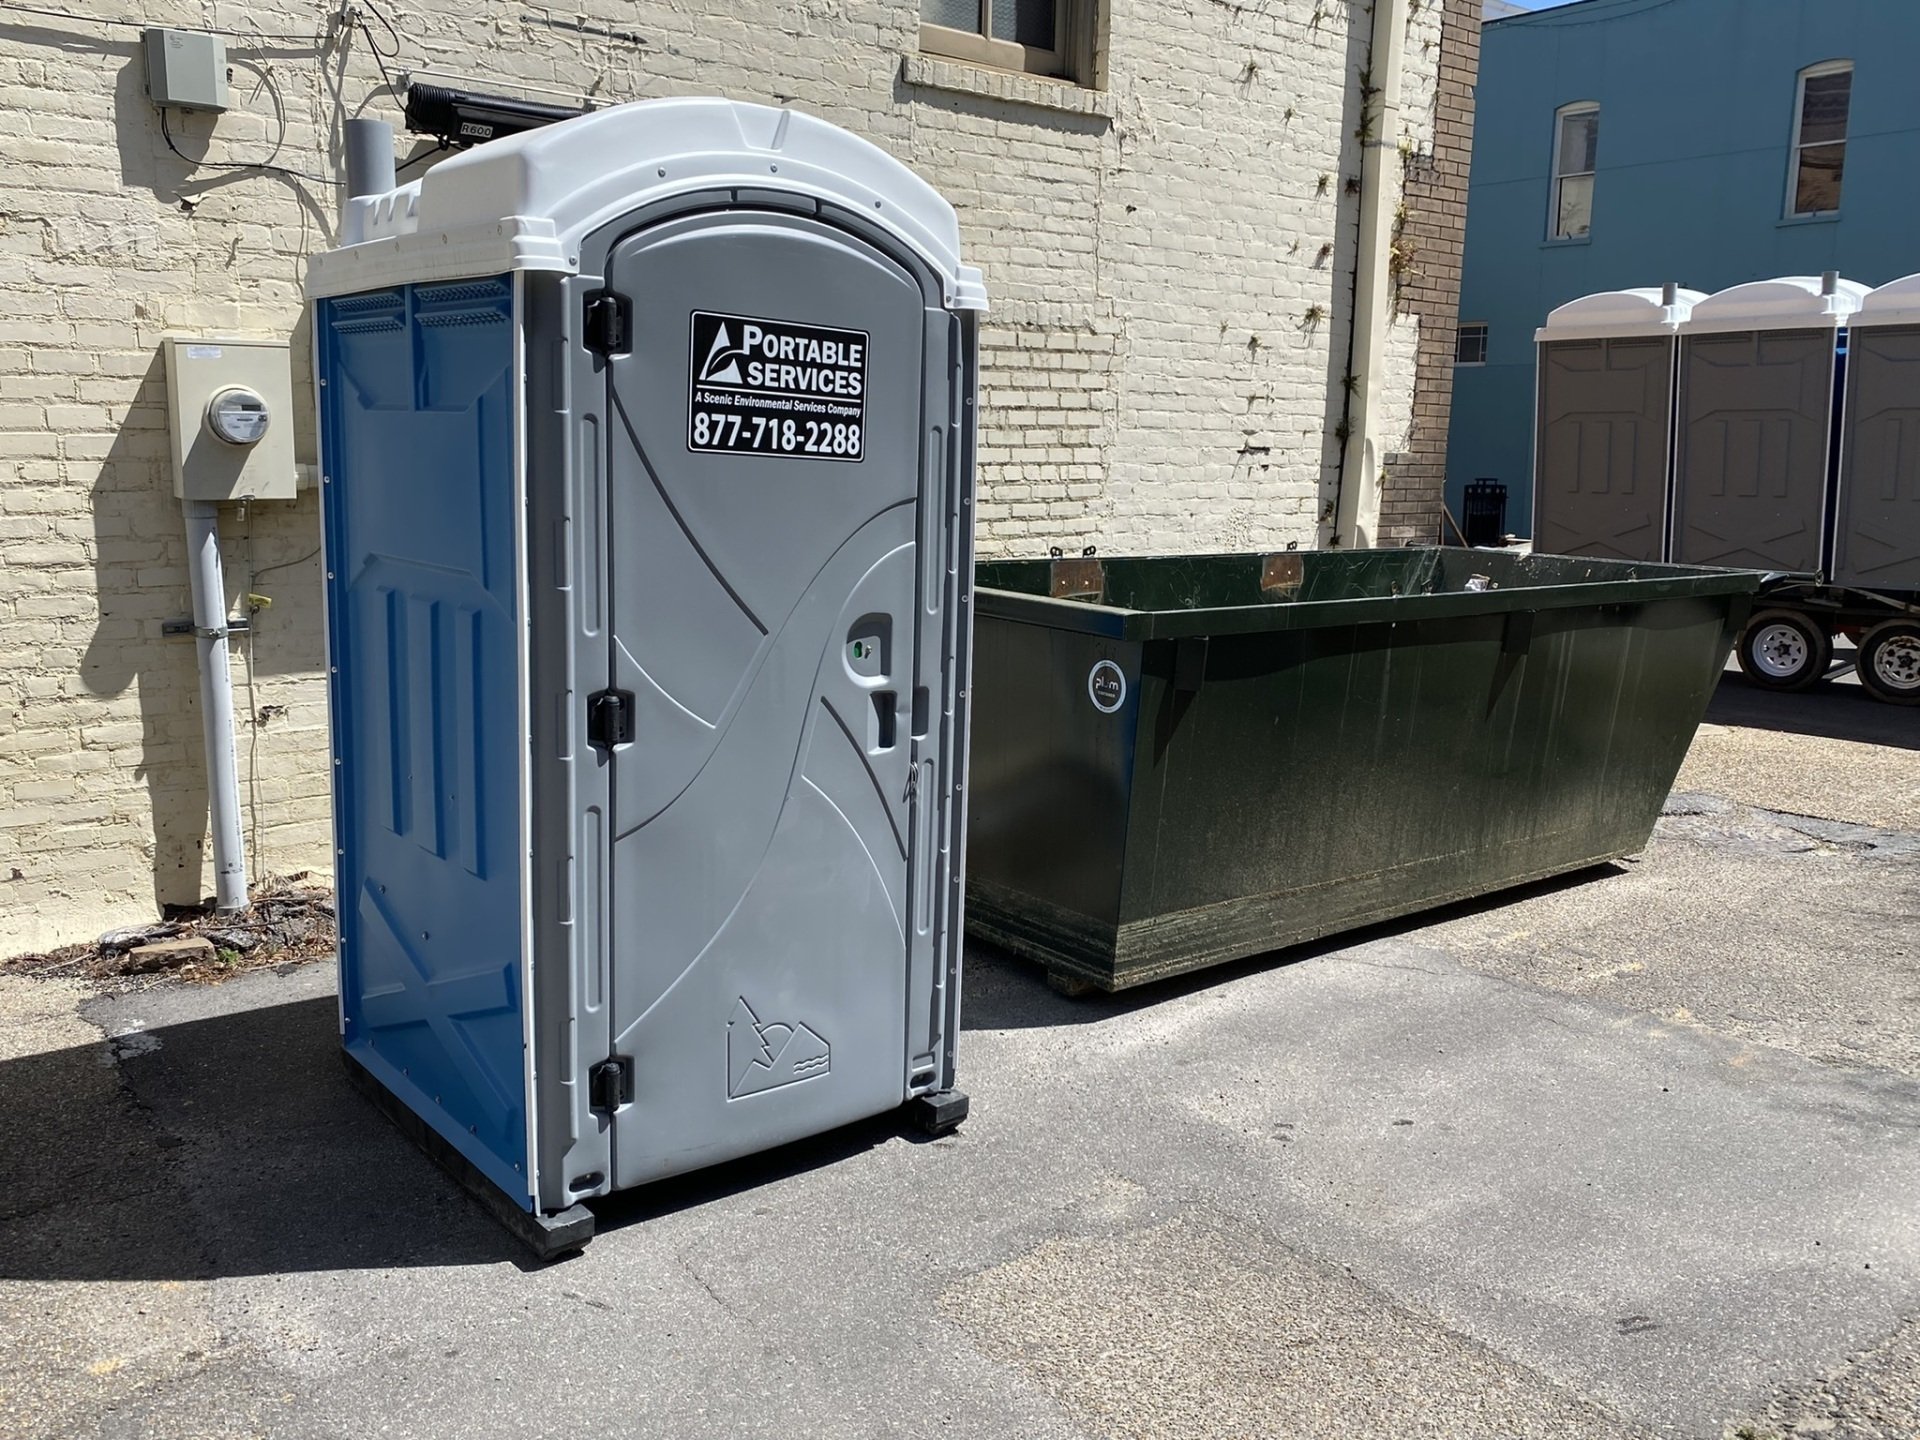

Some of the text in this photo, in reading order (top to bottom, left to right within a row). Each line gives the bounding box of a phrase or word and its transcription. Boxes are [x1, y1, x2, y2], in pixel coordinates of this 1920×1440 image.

[462, 125, 491, 136] R600
[743, 324, 862, 367] PORTABLE
[747, 361, 862, 395] SERVICES
[695, 391, 861, 418] A Scenic Environmental Services Company
[694, 412, 860, 455] 877-718-2288
